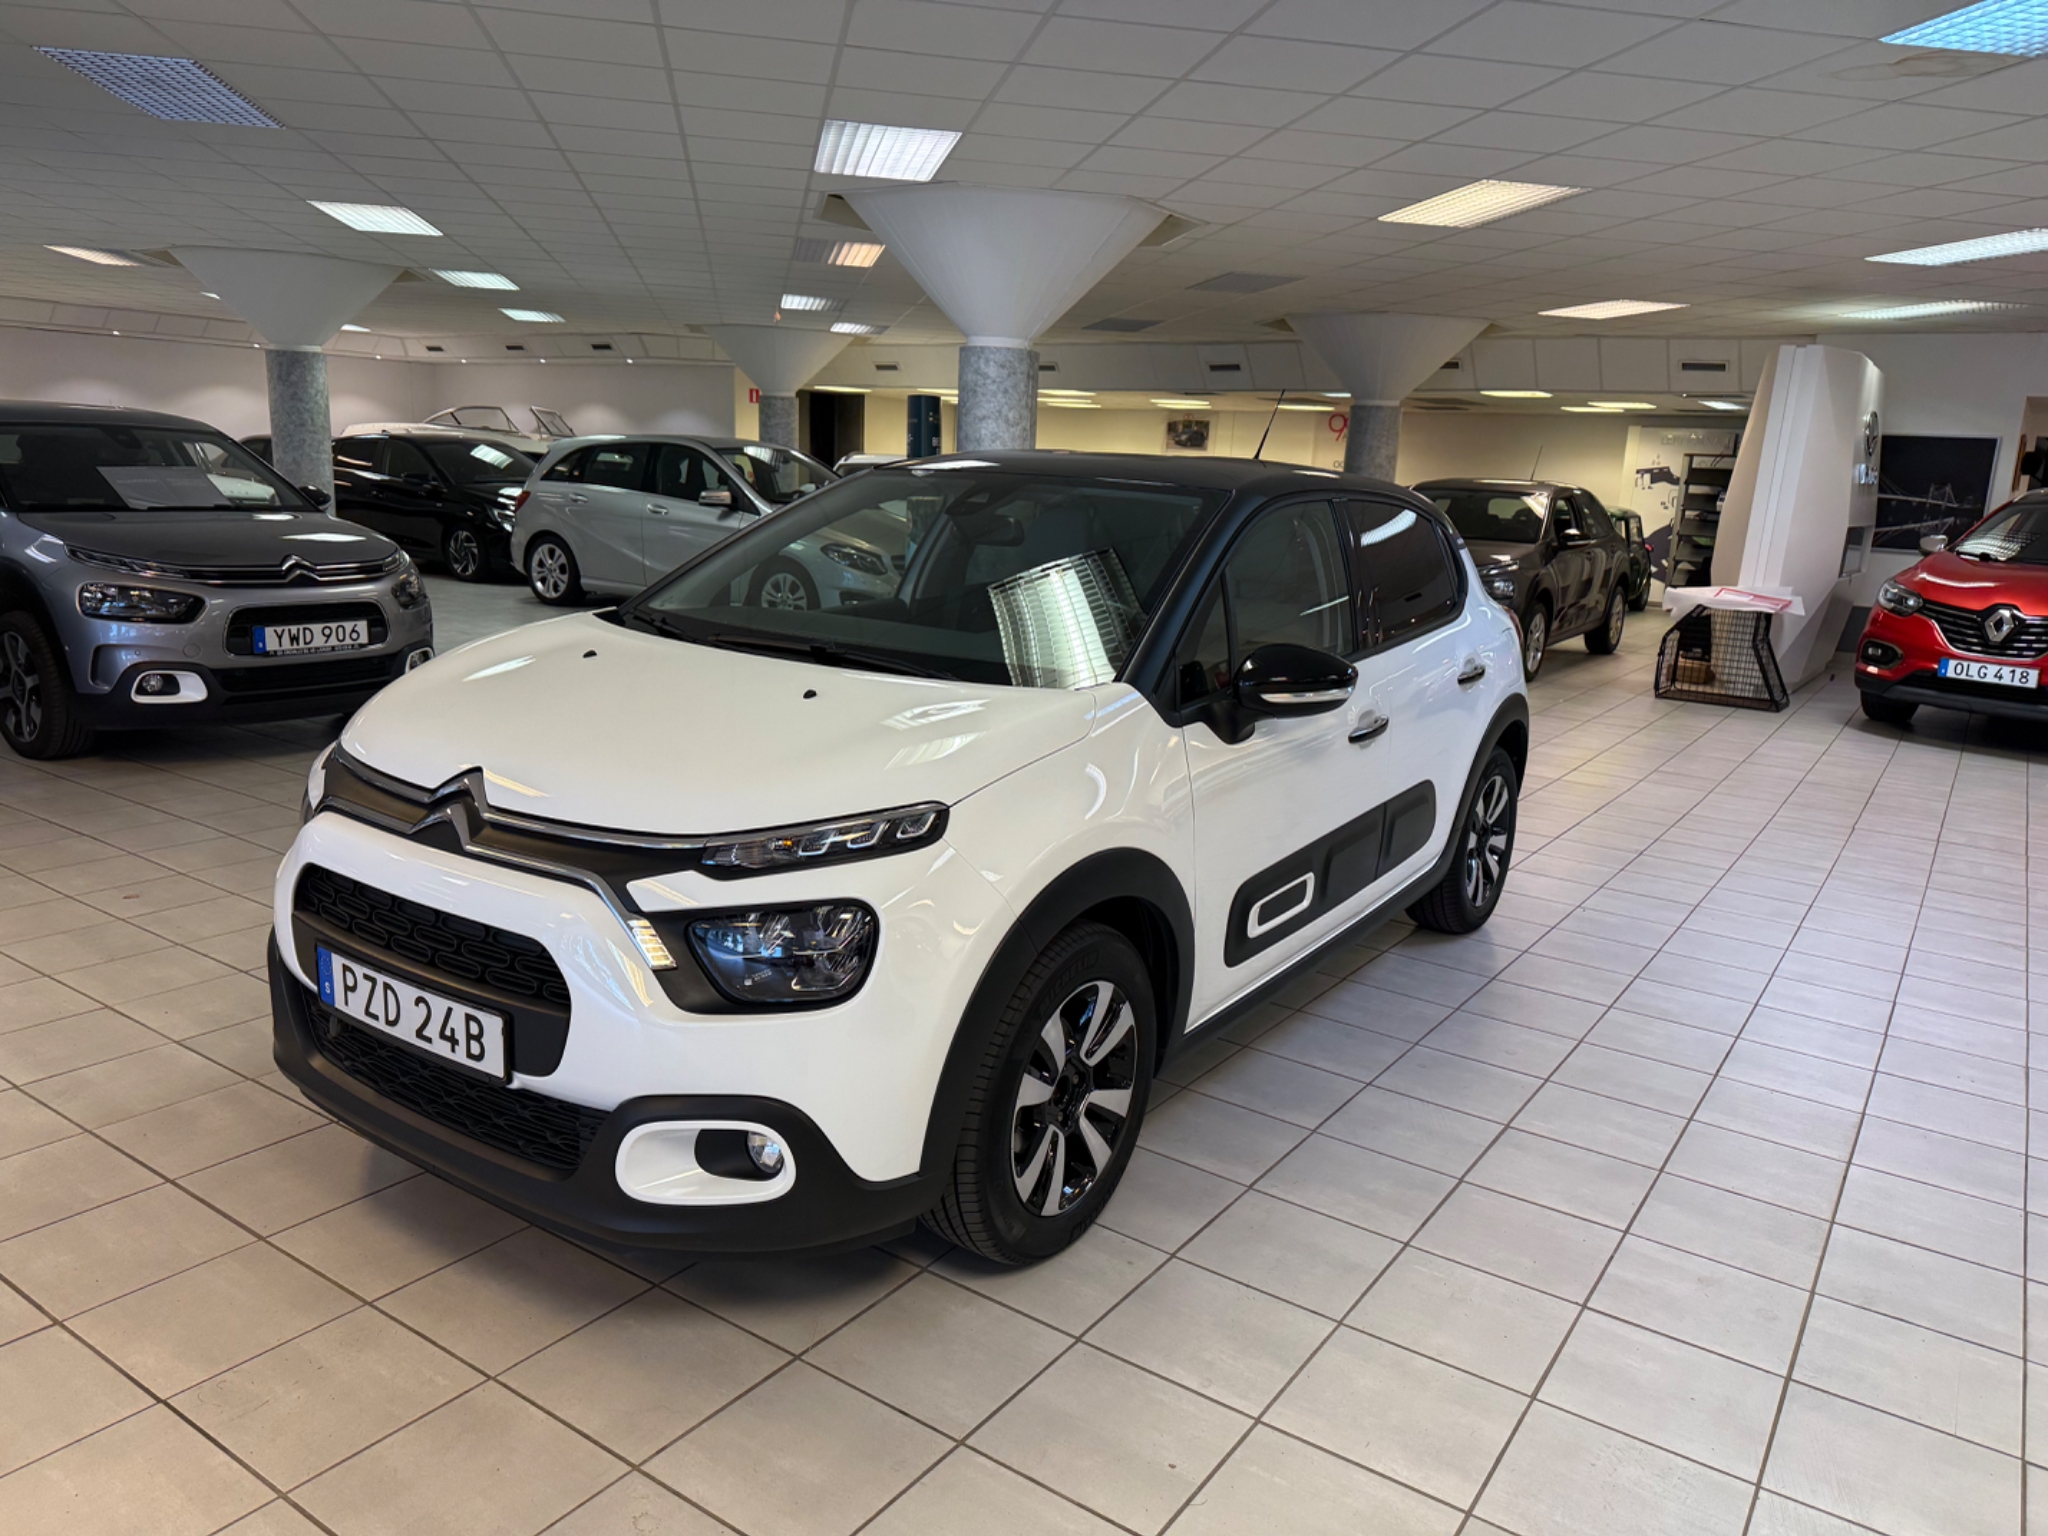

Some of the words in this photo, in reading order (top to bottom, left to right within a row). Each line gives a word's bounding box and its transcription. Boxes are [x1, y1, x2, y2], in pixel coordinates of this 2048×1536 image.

[273, 627, 314, 648] YWD
[320, 623, 361, 644] 906
[1954, 662, 1988, 679] OLG
[1993, 667, 2030, 684] 418
[324, 981, 331, 994] S
[341, 963, 401, 1027] PZD
[414, 995, 486, 1062] 24B
